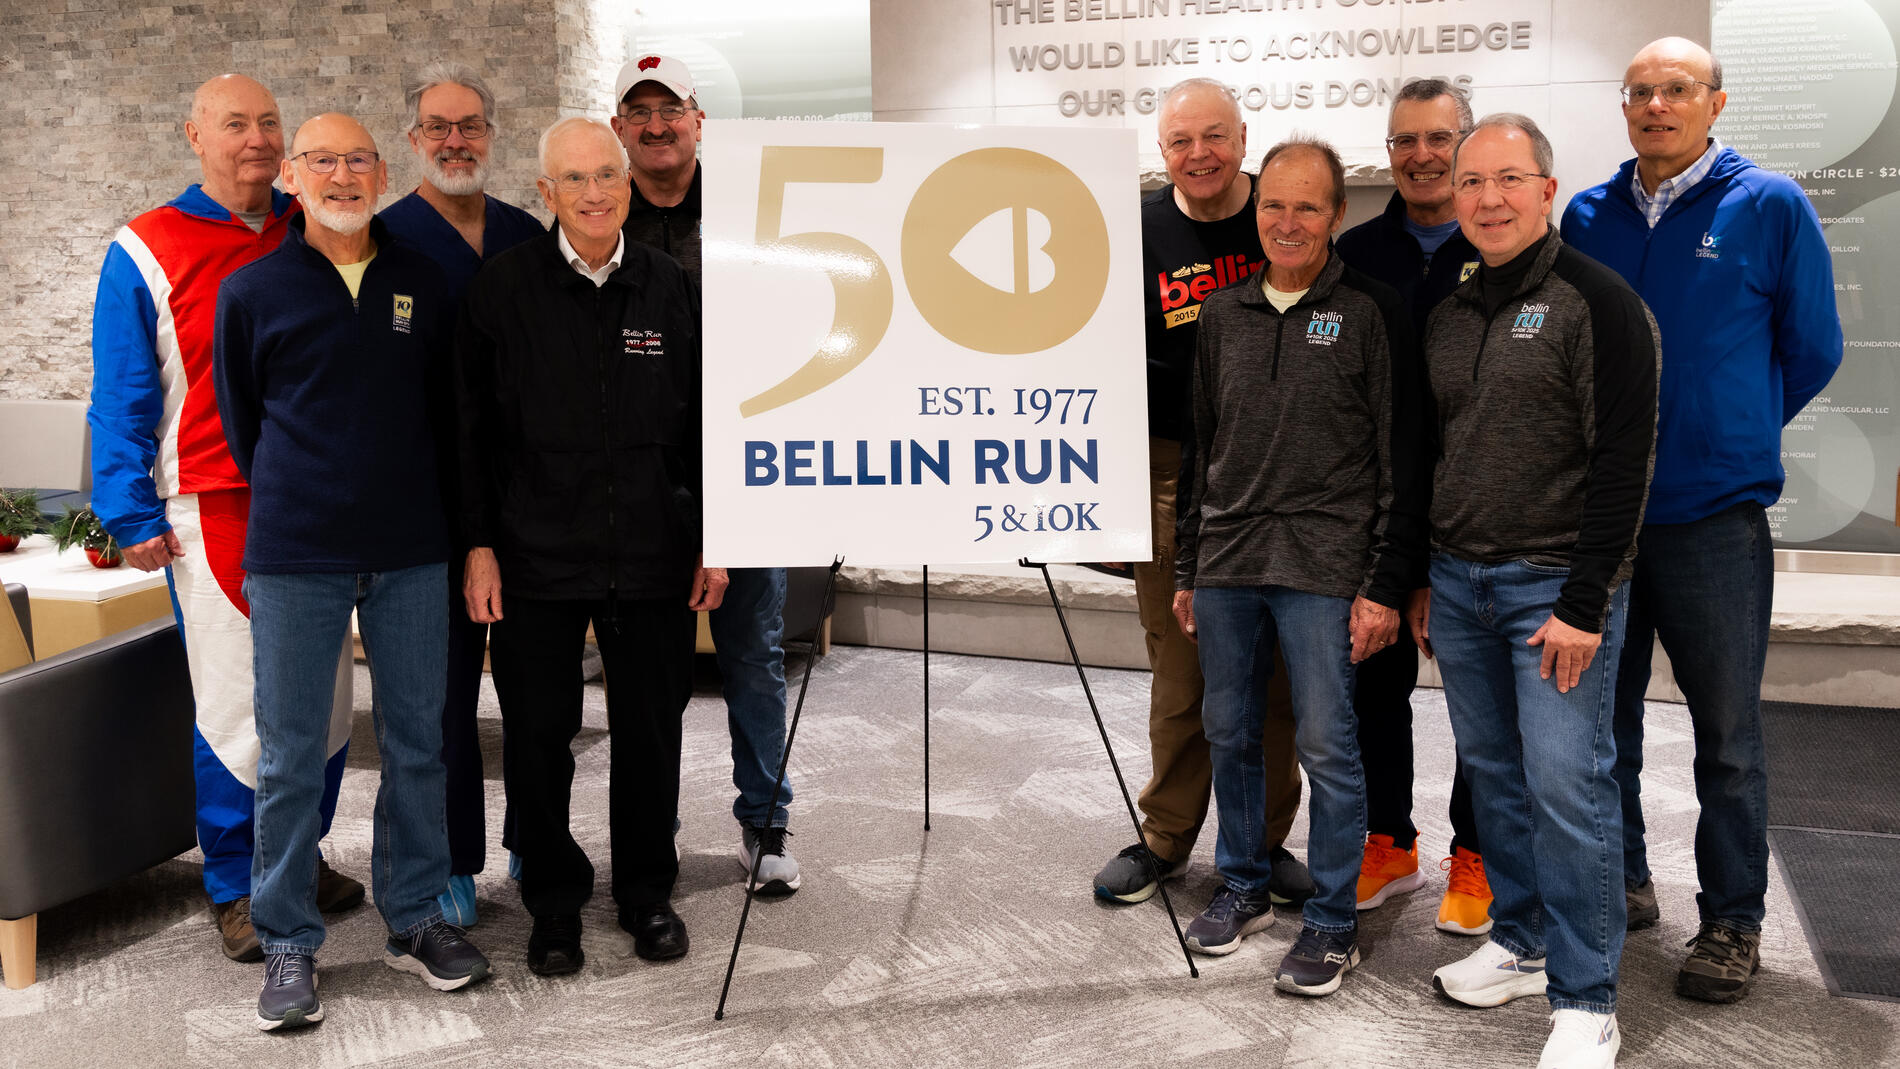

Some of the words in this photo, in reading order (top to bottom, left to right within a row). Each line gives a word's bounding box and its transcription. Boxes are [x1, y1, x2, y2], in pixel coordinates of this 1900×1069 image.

[995, 0, 1055, 25] THE
[1063, 0, 1169, 22] BELLIN
[1008, 41, 1125, 72] WOULD
[1135, 37, 1200, 67] LIKE
[1209, 36, 1252, 63] TO
[1261, 20, 1533, 61] ACKNOWLEDGE
[1058, 88, 1126, 118] OUR
[1134, 81, 1314, 114] GOUS
[1760, 161, 1800, 169] COMPANY
[1812, 168, 1864, 179] CIRCLE
[1174, 309, 1196, 322] 2015
[1521, 303, 1550, 313] bellin
[1312, 310, 1343, 322] bellin
[1513, 313, 1544, 328] run
[622, 328, 643, 337] Bellin
[644, 330, 662, 338] Run
[1307, 320, 1340, 337] run
[918, 387, 996, 417] EST.
[1013, 388, 1099, 425] 1977
[744, 440, 950, 487] BELLIN
[974, 438, 1099, 485] RUN
